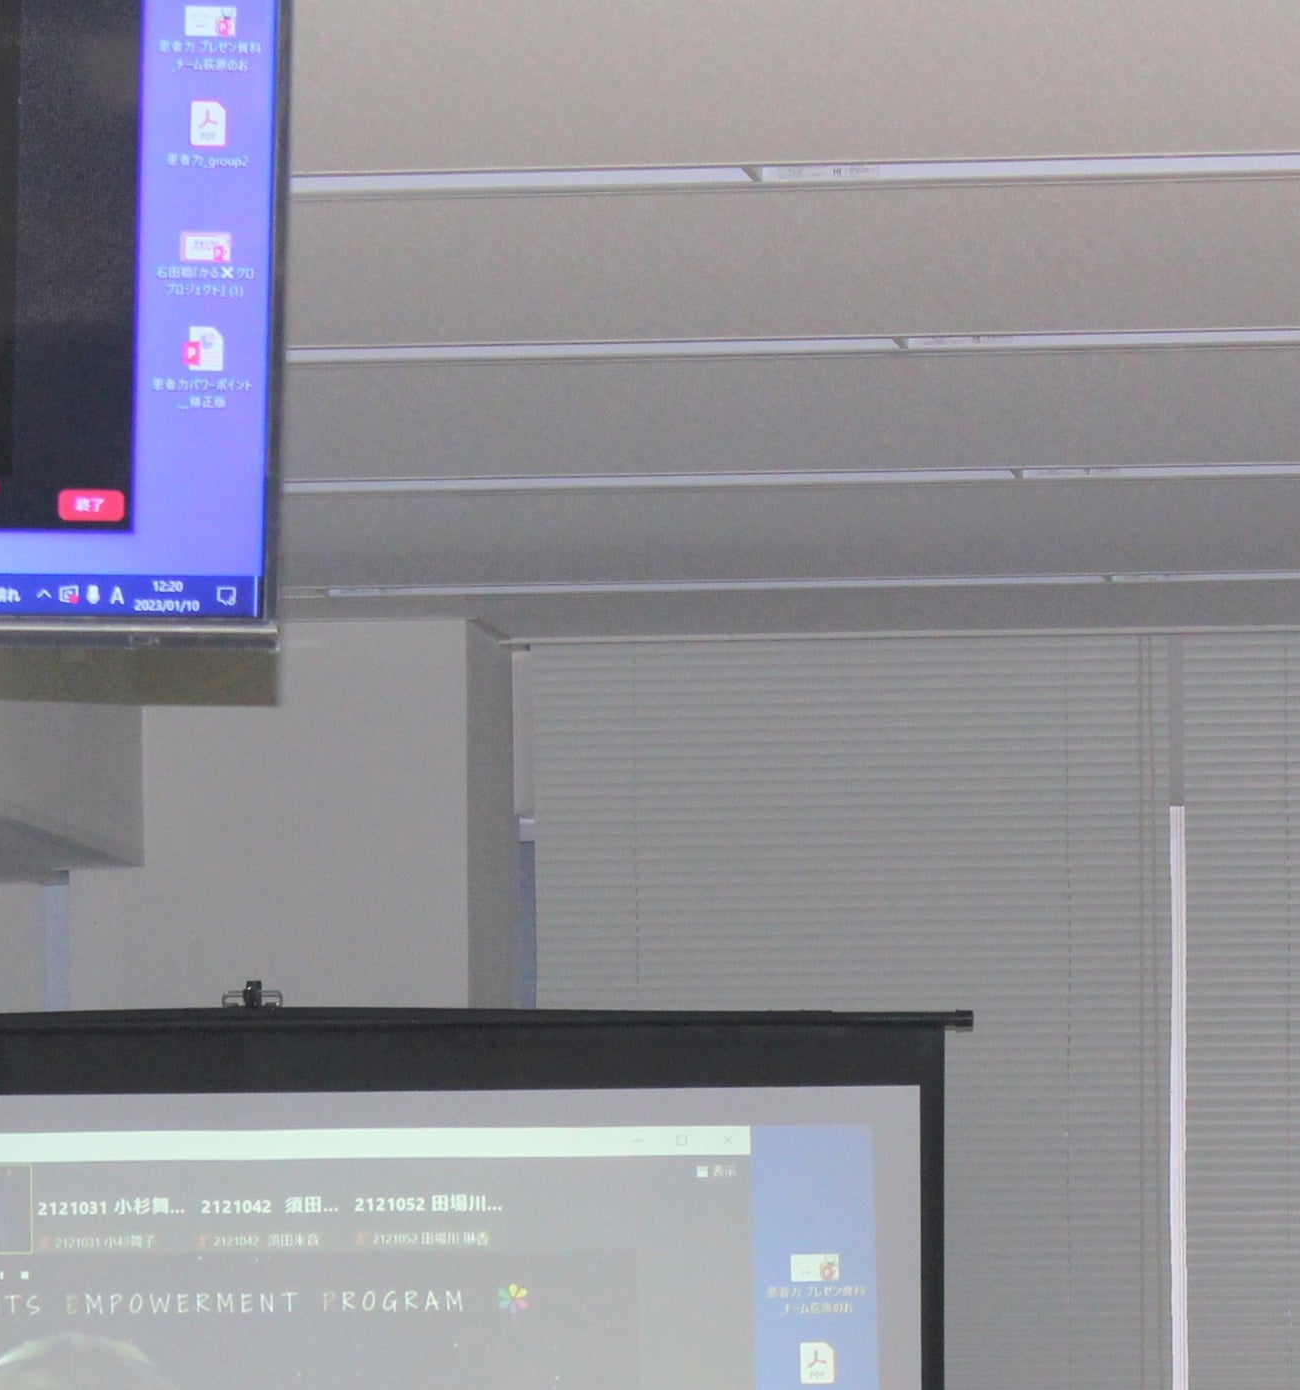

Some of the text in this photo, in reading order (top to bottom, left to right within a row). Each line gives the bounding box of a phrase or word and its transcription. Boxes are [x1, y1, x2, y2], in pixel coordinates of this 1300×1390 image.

[74, 497, 104, 512] 終了
[152, 580, 183, 593] 12:20
[110, 586, 124, 605] A
[134, 599, 200, 612] 2023/01/10
[38, 1201, 107, 1216] 2121031
[201, 1200, 272, 1214] 2121042
[355, 1197, 425, 1212] 2121052
[55, 1237, 100, 1248] 2121031
[214, 1236, 259, 1246] 2121042
[373, 1234, 418, 1245] 2121052
[421, 1232, 459, 1245] 田場川
[66, 1292, 299, 1315] EMPOWERMENT
[323, 1290, 463, 1313] PROGRAM
